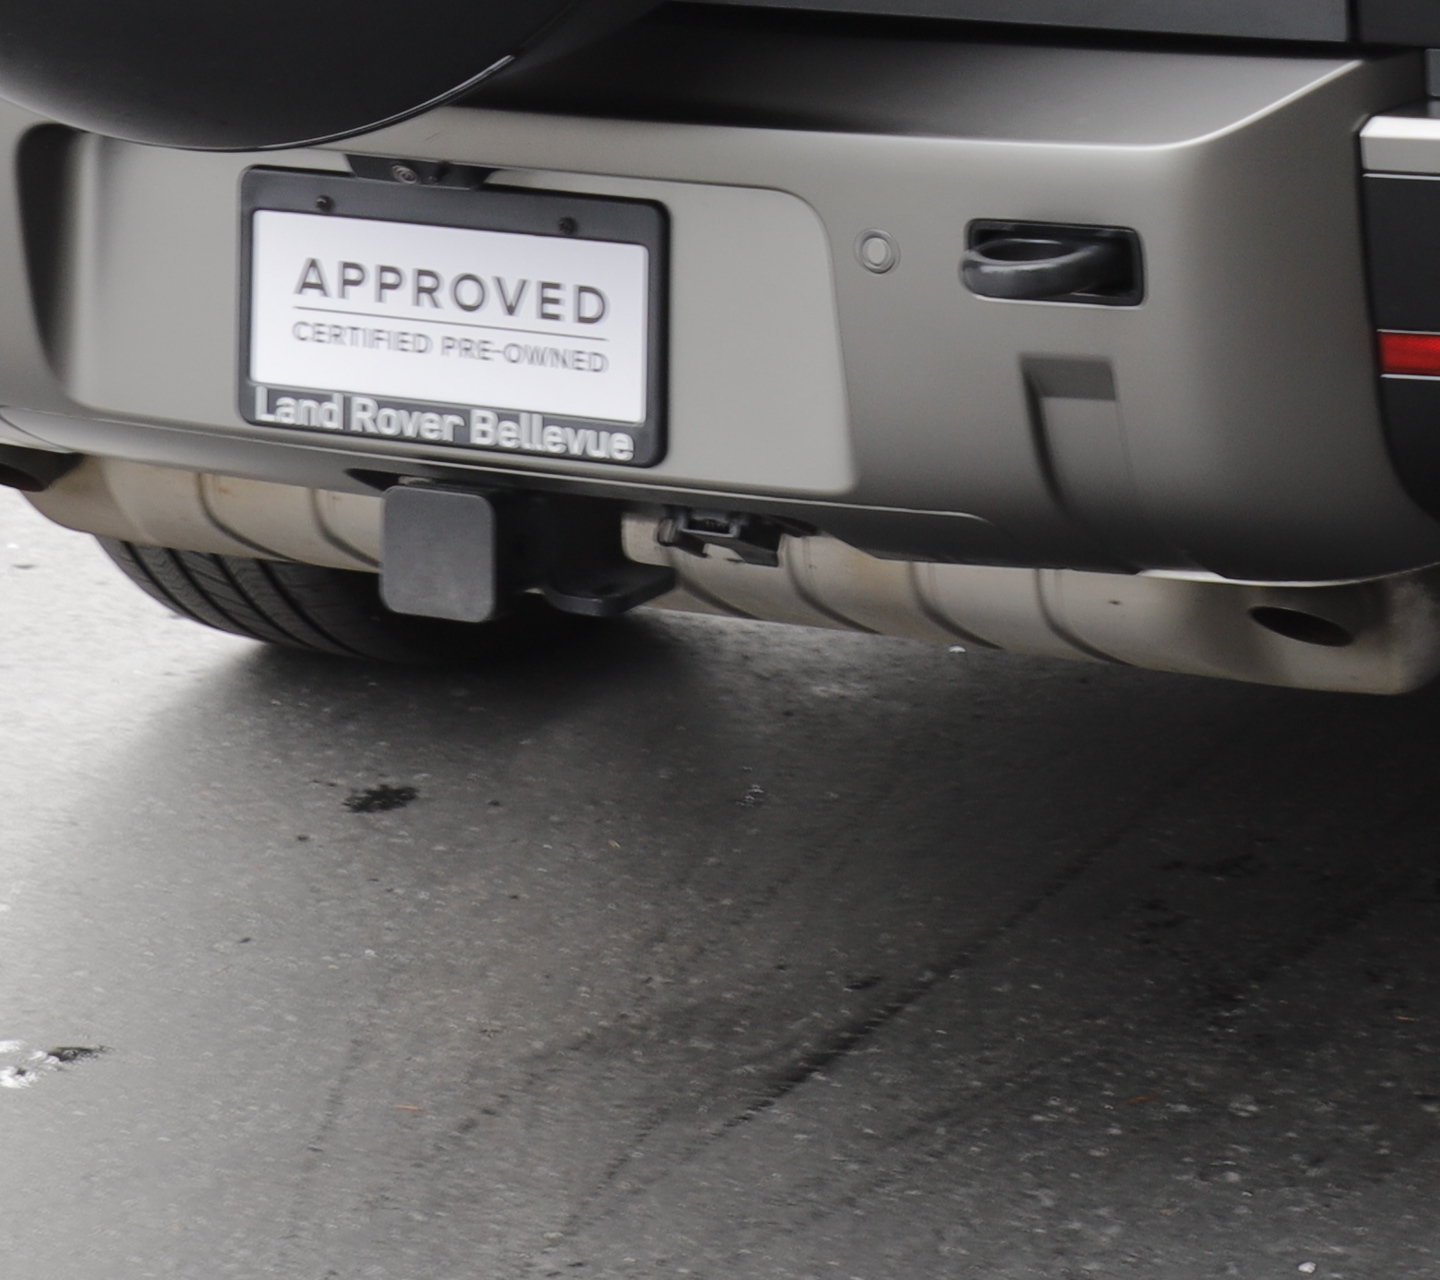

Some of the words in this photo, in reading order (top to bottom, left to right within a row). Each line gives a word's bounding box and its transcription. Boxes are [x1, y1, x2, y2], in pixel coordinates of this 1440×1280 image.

[293, 257, 610, 325] APPROVED
[292, 320, 433, 355] CERTIFIED
[441, 336, 609, 373] PRE-OWNED
[255, 385, 343, 430] Land
[350, 397, 465, 442] Rover
[470, 408, 635, 462] Bellevue
